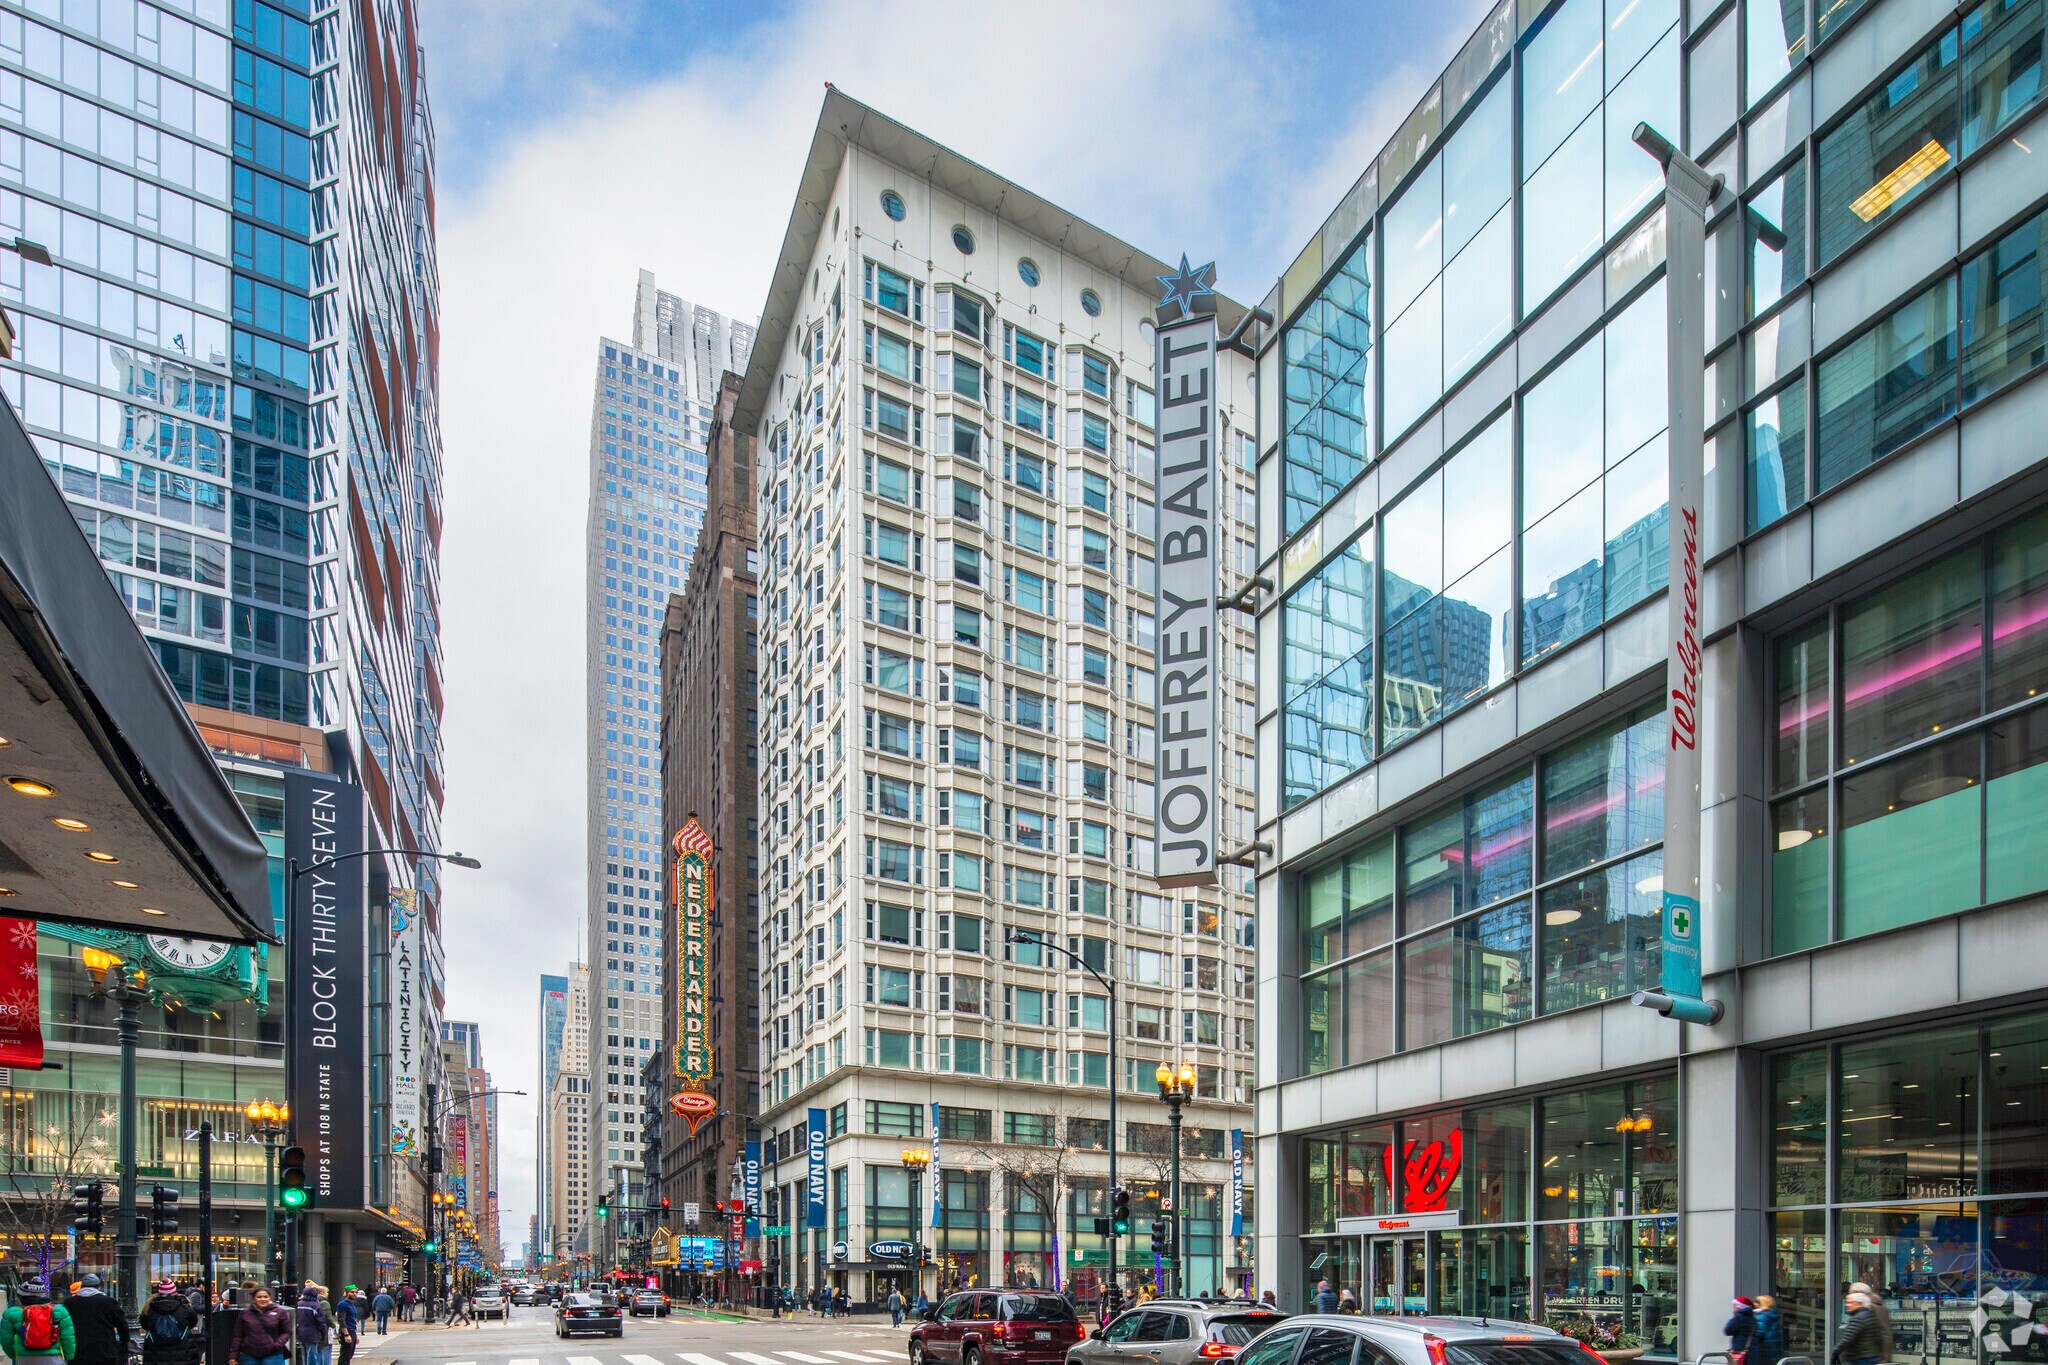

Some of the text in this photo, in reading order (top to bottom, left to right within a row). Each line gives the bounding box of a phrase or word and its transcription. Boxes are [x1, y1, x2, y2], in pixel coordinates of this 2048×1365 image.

[1162, 336, 1208, 867] JOFFREY BALLET
[1671, 505, 1700, 753] Walgreens
[313, 788, 336, 1048] BLOCK THIRTY SEVEN
[1663, 938, 1699, 960] pharmacy
[686, 863, 702, 1072] NEDERLANDER
[398, 940, 412, 1073] LATINICITY
[319, 1063, 330, 1100] STATE
[396, 1075, 415, 1083] FOOD
[396, 1082, 415, 1090] HALL
[682, 1096, 706, 1108] Chicago
[319, 1113, 330, 1135] 108
[319, 1140, 330, 1154] AT
[319, 1158, 330, 1196] SHOPS
[456, 1154, 465, 1180] IRON
[747, 1160, 759, 1186] OLD
[811, 1130, 825, 1206] OLD NAVY
[1233, 1149, 1243, 1215] OLD NAVY
[456, 1183, 465, 1210] GOLF
[875, 1245, 914, 1254] OLD NY
[1603, 1296, 1636, 1305] DRUS
